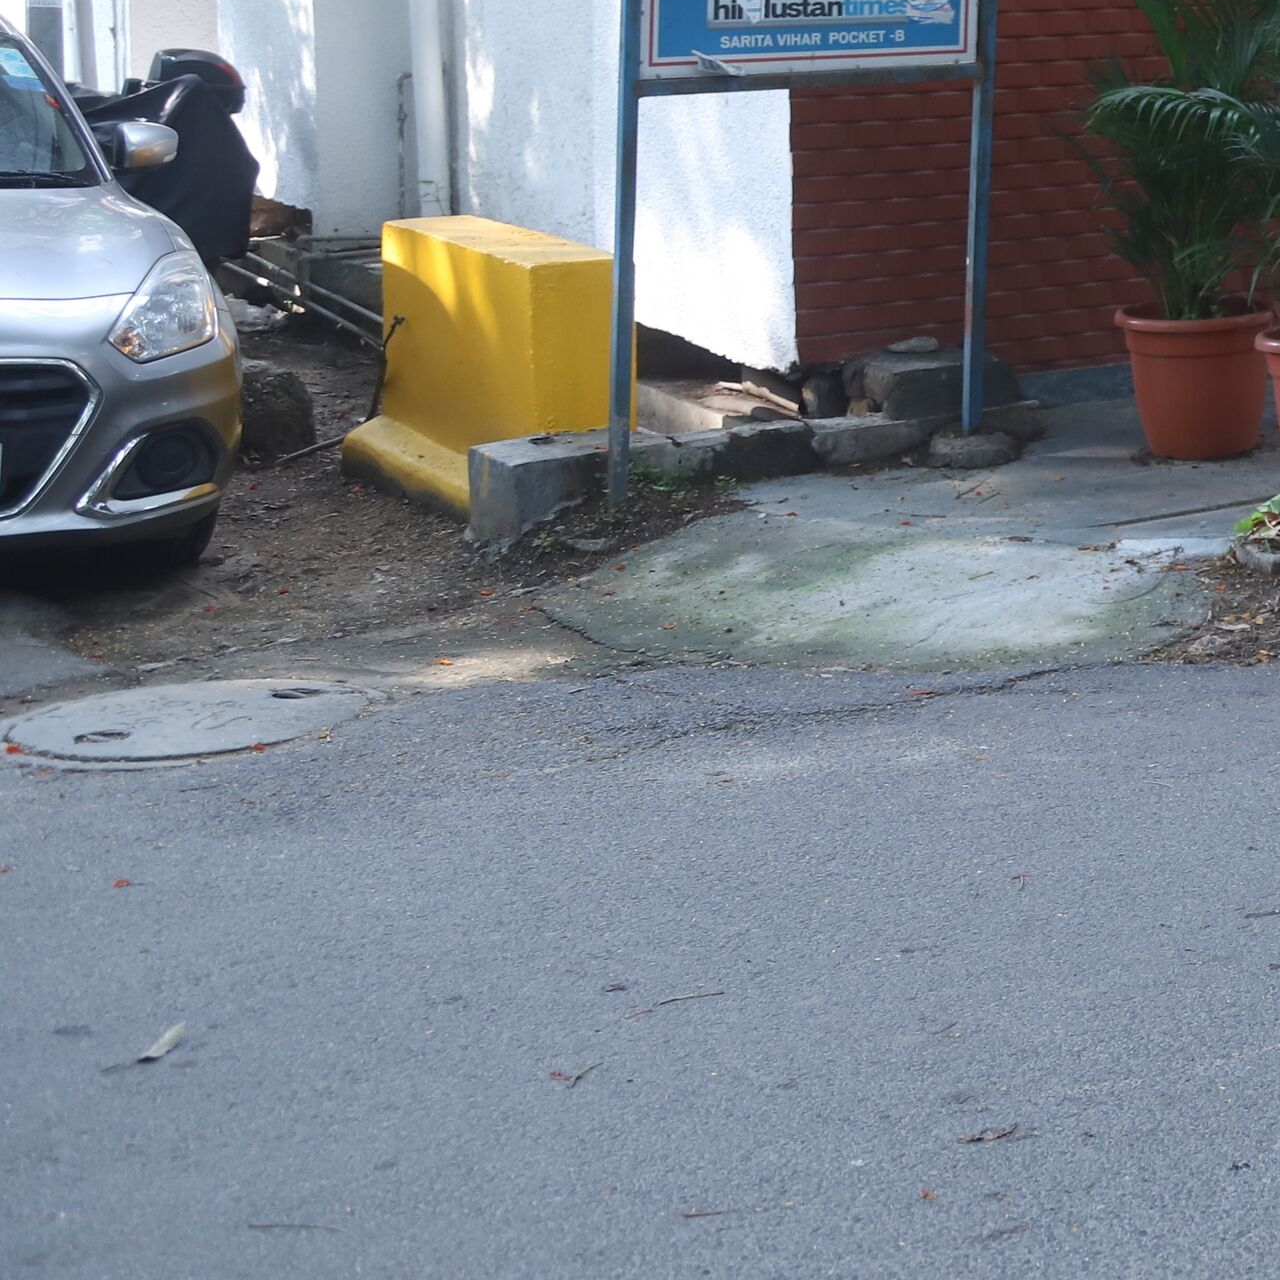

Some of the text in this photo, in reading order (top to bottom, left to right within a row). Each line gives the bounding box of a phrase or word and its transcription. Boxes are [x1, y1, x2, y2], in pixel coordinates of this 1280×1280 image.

[720, 34, 773, 49] SARITA
[777, 32, 822, 46] VIHAR
[829, 31, 886, 45] POCKET
